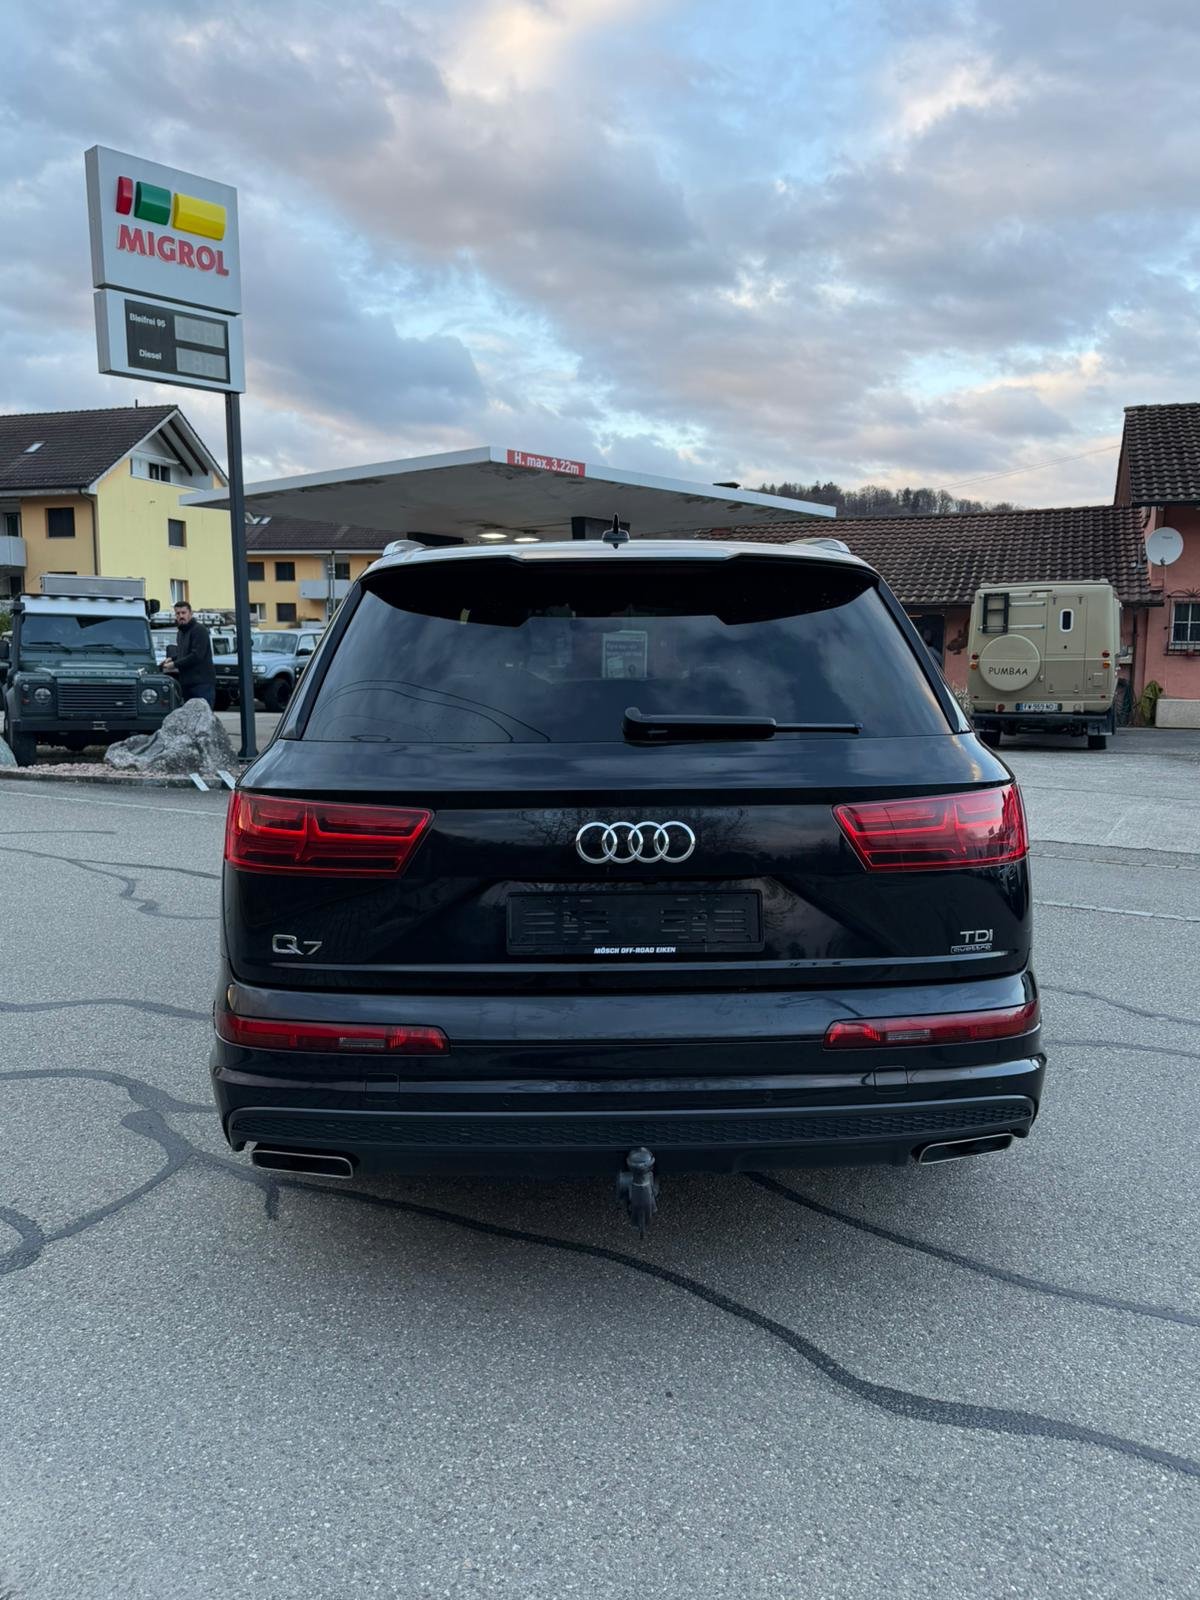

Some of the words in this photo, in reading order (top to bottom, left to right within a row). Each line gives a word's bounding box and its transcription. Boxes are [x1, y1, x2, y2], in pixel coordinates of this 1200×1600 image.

[117, 224, 230, 276] MIGROL
[129, 312, 156, 326] Bleifrei
[138, 349, 162, 360] Diesel
[514, 451, 525, 465] H.
[526, 456, 550, 470] max.
[551, 459, 579, 475] 3.22m
[988, 666, 1028, 676] PUMBAA
[960, 928, 993, 943] TDI
[272, 934, 322, 955] Q7
[593, 946, 620, 954] MÖSCH
[620, 946, 655, 954] OFF-ROAD
[655, 946, 677, 954] EIKEN
